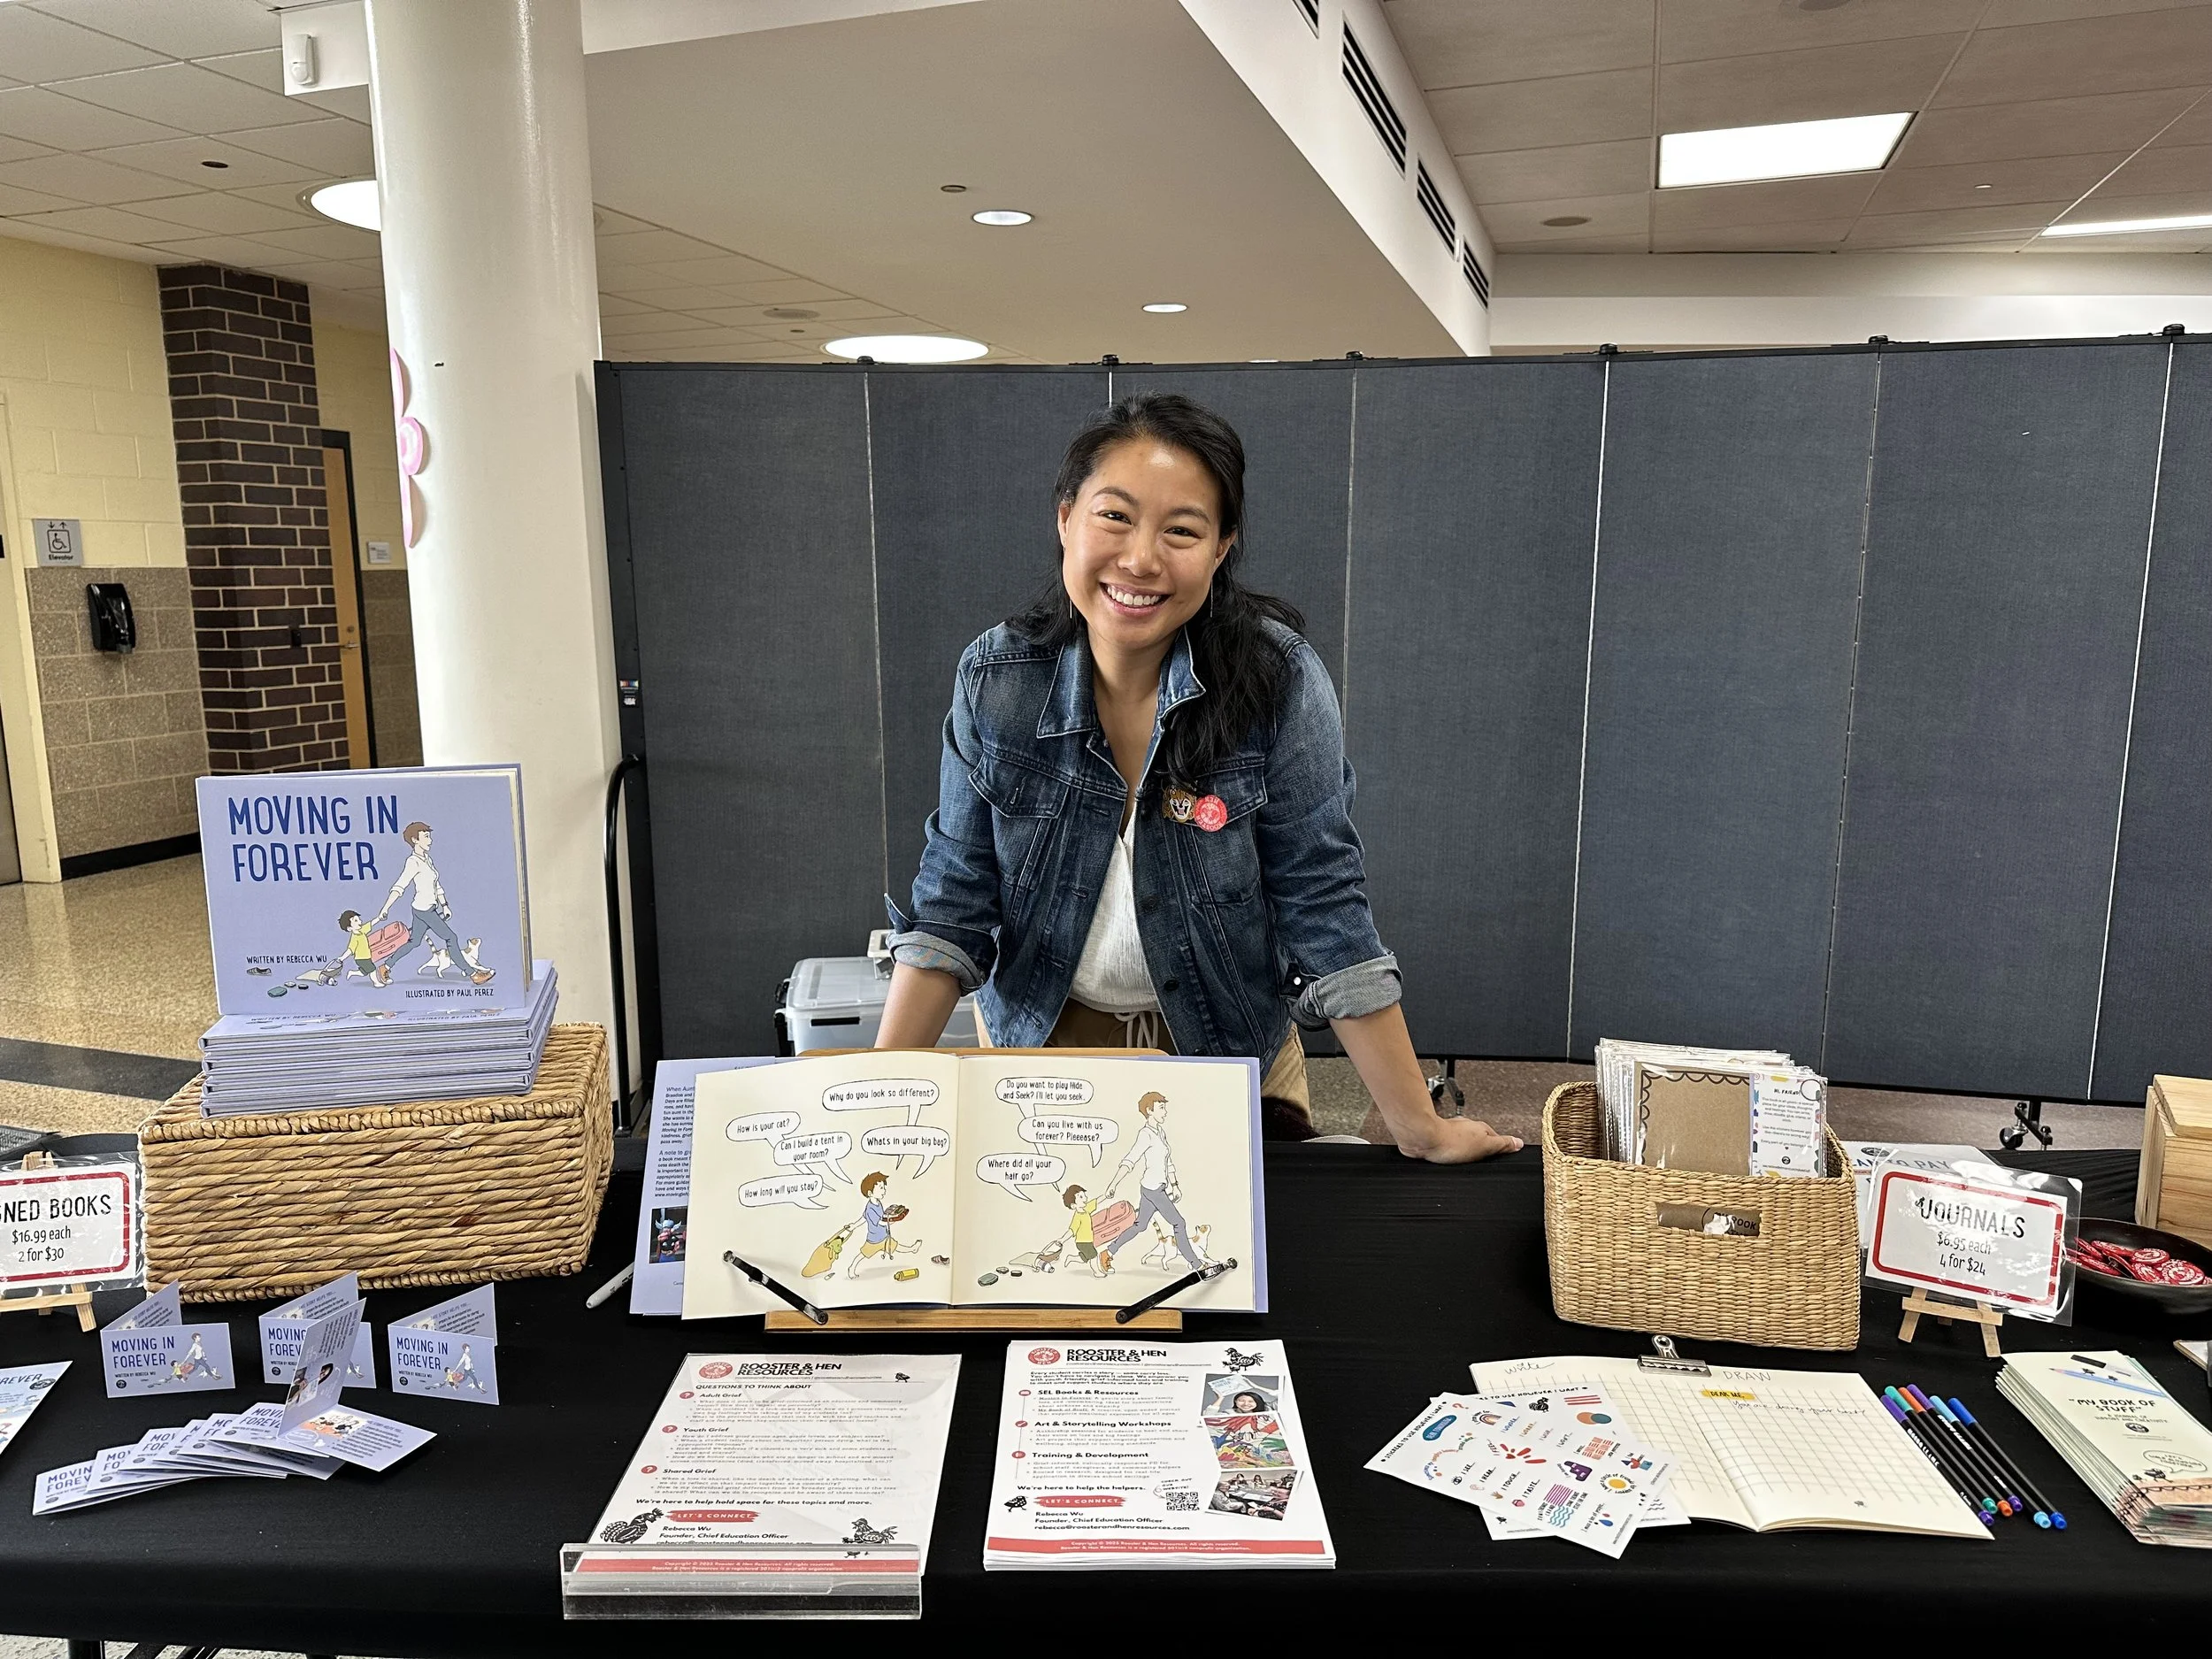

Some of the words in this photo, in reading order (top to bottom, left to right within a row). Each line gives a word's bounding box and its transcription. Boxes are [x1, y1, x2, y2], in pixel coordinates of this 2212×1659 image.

[228, 795, 351, 835] MOVING
[367, 795, 398, 834] IN
[233, 842, 379, 882] FOREVER
[287, 955, 314, 964] REBECCA
[1017, 1081, 1027, 1090] you
[1056, 1081, 1068, 1091] play
[830, 1093, 843, 1102] Why
[898, 1088, 934, 1097] different?
[1069, 1092, 1086, 1101] seek.
[760, 1122, 774, 1132] your
[777, 1118, 789, 1128] cat?
[1032, 1119, 1044, 1128] Can
[1048, 1121, 1059, 1130] you
[1062, 1120, 1073, 1129] live
[1077, 1120, 1092, 1129] with
[780, 1141, 791, 1150] Can
[798, 1138, 812, 1148] build
[820, 1136, 834, 1145] tent
[902, 1137, 918, 1146] your
[921, 1137, 931, 1147] big
[933, 1137, 947, 1148] bag?
[1035, 1132, 1064, 1141] forever?
[1066, 1132, 1100, 1141] Pleeease?
[794, 1152, 807, 1162] your
[810, 1148, 828, 1159] room?
[988, 1159, 1010, 1168] Where
[1012, 1159, 1022, 1168] did
[1025, 1159, 1033, 1168] all
[1035, 1160, 1052, 1169] your
[1914, 1160, 1951, 1170] PAY
[1021, 1171, 1033, 1181] go?
[745, 1189, 757, 1198] How
[760, 1187, 772, 1197] long
[775, 1185, 785, 1194] will
[787, 1185, 798, 1194] you
[801, 1180, 818, 1191] stay?
[0, 1200, 40, 1223] NED
[50, 1194, 111, 1219] BOOKS
[1920, 1199, 2025, 1239] JOURNALS
[12, 1229, 47, 1245] $16.99
[50, 1225, 71, 1240] each
[1937, 1232, 1965, 1252] $6.95
[1969, 1239, 1991, 1256] each
[19, 1251, 25, 1263] 2
[27, 1248, 43, 1262] for
[45, 1247, 65, 1262] $30
[1939, 1255, 1946, 1268] 4
[1948, 1254, 1965, 1268] for
[1967, 1256, 1985, 1276] $24
[111, 1338, 157, 1353] MOVING
[163, 1336, 174, 1349] IN
[396, 1337, 434, 1353] MOVING
[438, 1342, 448, 1355] IN
[113, 1353, 166, 1369] FOREVER
[397, 1353, 441, 1370] FOREVER
[0, 1373, 42, 1385] REVER
[1723, 1371, 1771, 1381] DRAW
[48, 1465, 93, 1484] MOVIN
